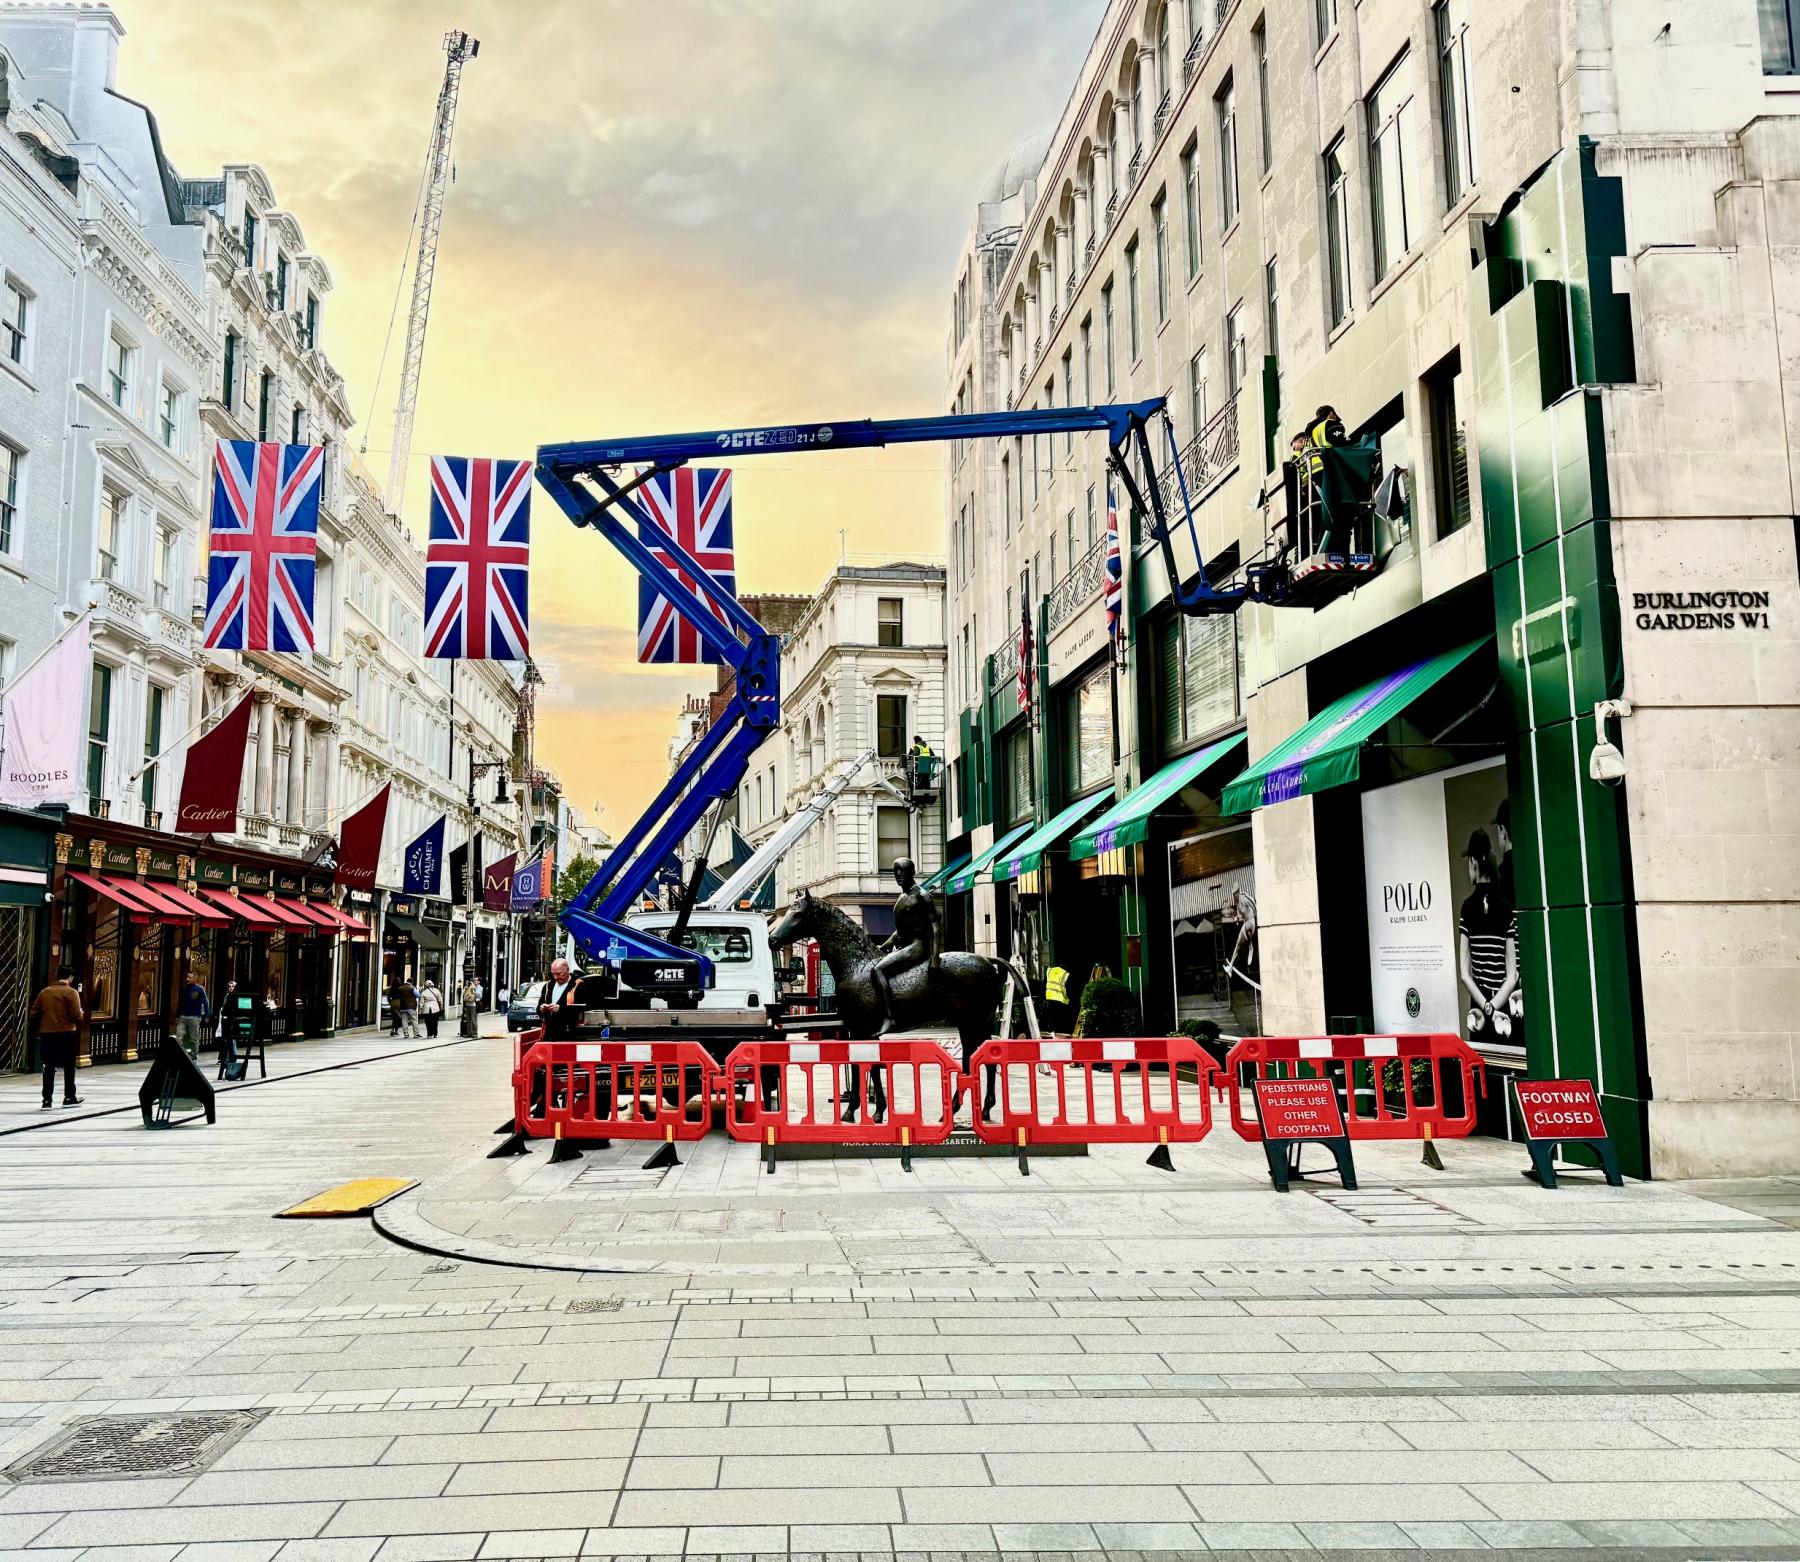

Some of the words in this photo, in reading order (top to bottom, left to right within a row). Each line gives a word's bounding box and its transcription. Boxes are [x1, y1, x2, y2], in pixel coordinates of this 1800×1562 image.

[1632, 591, 1770, 609] BURLINGTON
[1636, 613, 1735, 630] GARDENS
[1740, 612, 1770, 629] W1
[10, 770, 69, 783] BOODLES
[1281, 772, 1308, 789] LAUREN
[181, 804, 233, 820] Cartier
[108, 849, 131, 865] Cartier
[152, 857, 172, 871] Cartier
[423, 839, 433, 890] CHAUMET
[204, 864, 225, 880] Cartier
[485, 874, 510, 892] M
[1383, 880, 1432, 913] POLO
[1390, 916, 1406, 924] RALPH
[664, 968, 685, 979] CTE
[1261, 1083, 1329, 1093] PEDESTRIANS
[1267, 1097, 1306, 1107] PLEASE
[1308, 1096, 1329, 1106] USE
[1521, 1092, 1591, 1104] FOOTWAY
[1284, 1111, 1318, 1120] OTHER
[1533, 1112, 1594, 1125] CLOSED
[1278, 1124, 1331, 1134] FOOTPATH
